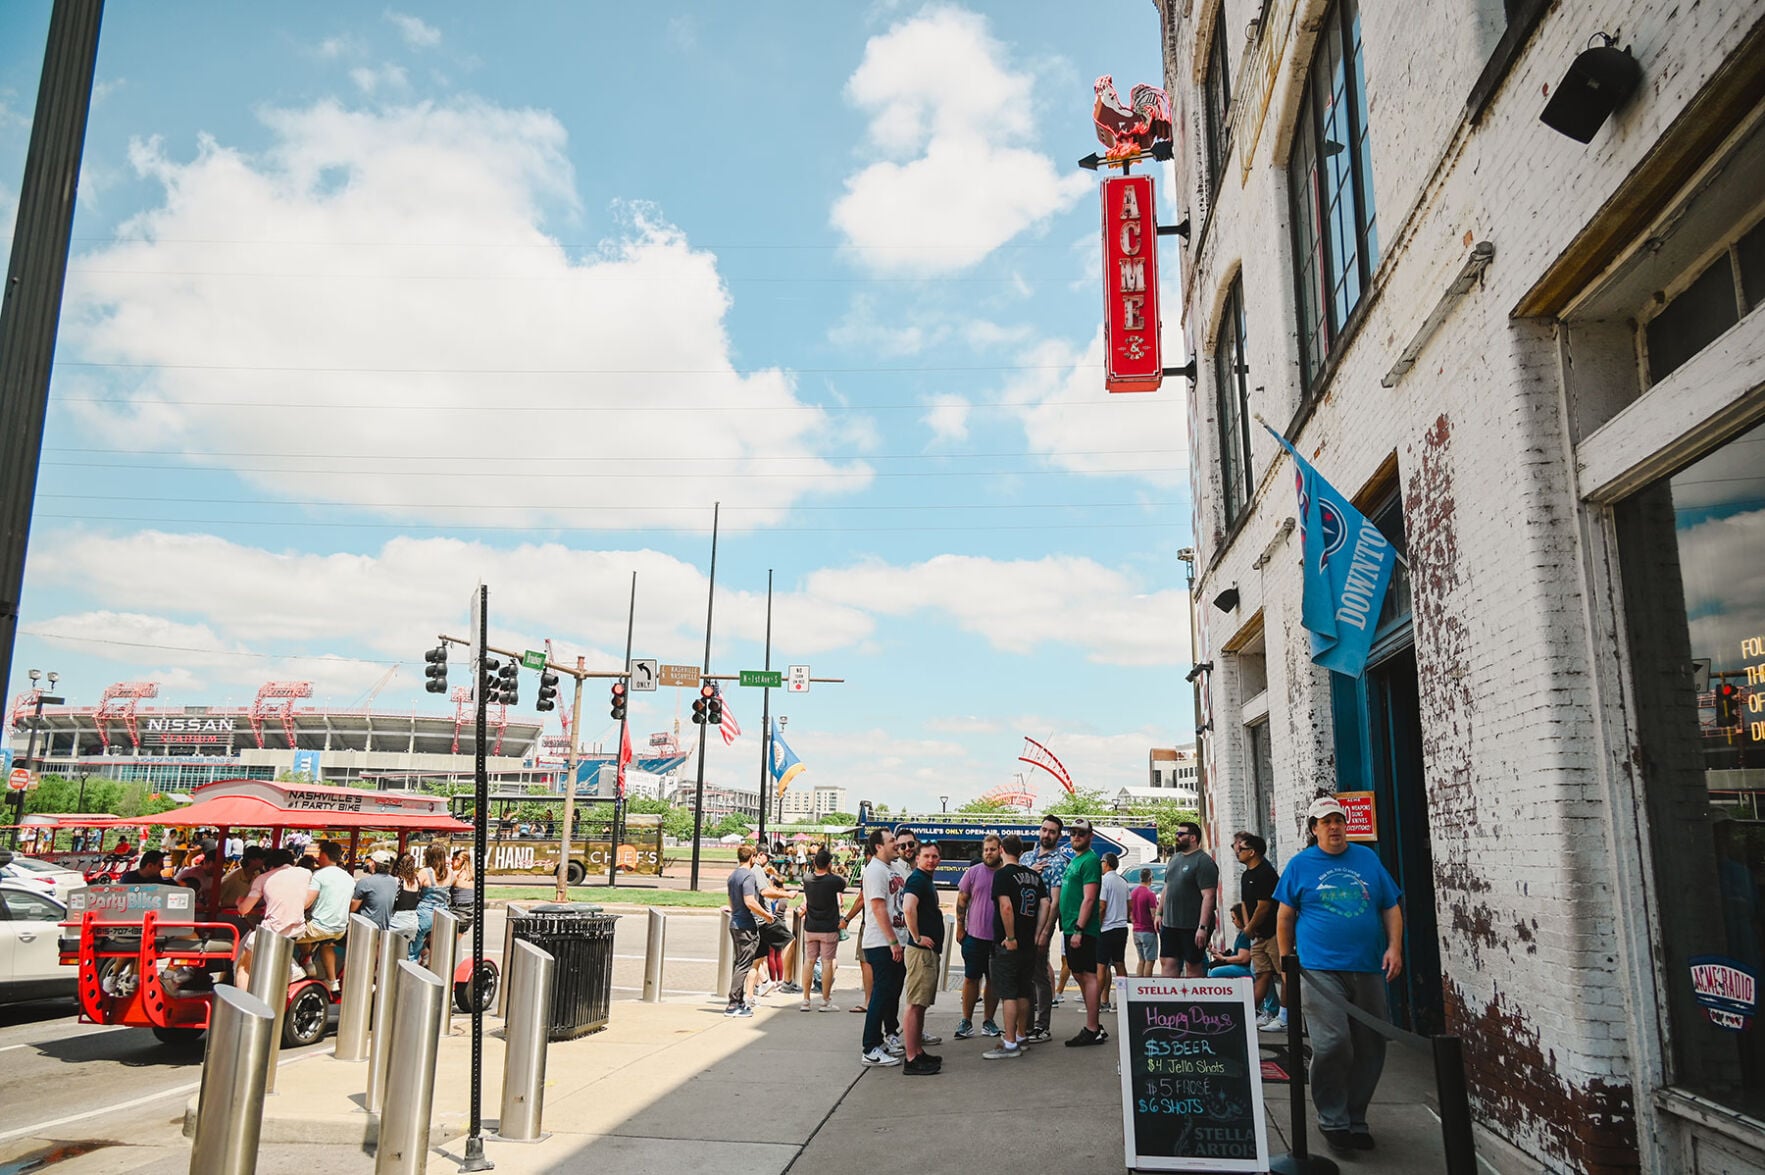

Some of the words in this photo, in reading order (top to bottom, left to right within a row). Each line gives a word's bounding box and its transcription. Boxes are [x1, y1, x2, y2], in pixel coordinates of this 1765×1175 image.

[1119, 185, 1147, 331] ACME
[1335, 517, 1389, 631] DOWNTO
[636, 681, 650, 689] ONLY
[148, 719, 234, 731] NISSAN
[159, 733, 218, 744] STADIUM
[288, 791, 362, 803] NASHVILLE'S
[301, 801, 336, 809] PARTY
[338, 803, 361, 812] BIKE
[1001, 829, 1040, 837] DOUBLE-DE
[1062, 829, 1071, 837] BU
[494, 846, 535, 869] HAND
[590, 851, 658, 864] CHIEF'S
[1020, 887, 1037, 917] 12
[1137, 986, 1178, 995] STELLA
[1191, 986, 1233, 995] ARTOIS
[1721, 967, 1752, 1001] RADIO
[1145, 1006, 1189, 1038] Happy
[1189, 1005, 1233, 1032] Days
[1147, 1059, 1162, 1073] $4
[1168, 1060, 1194, 1073] Jello
[1196, 1060, 1225, 1074] Shots
[1138, 1097, 1159, 1113] $6
[1161, 1098, 1204, 1115] SHOTS
[1194, 1127, 1254, 1142] STELLA
